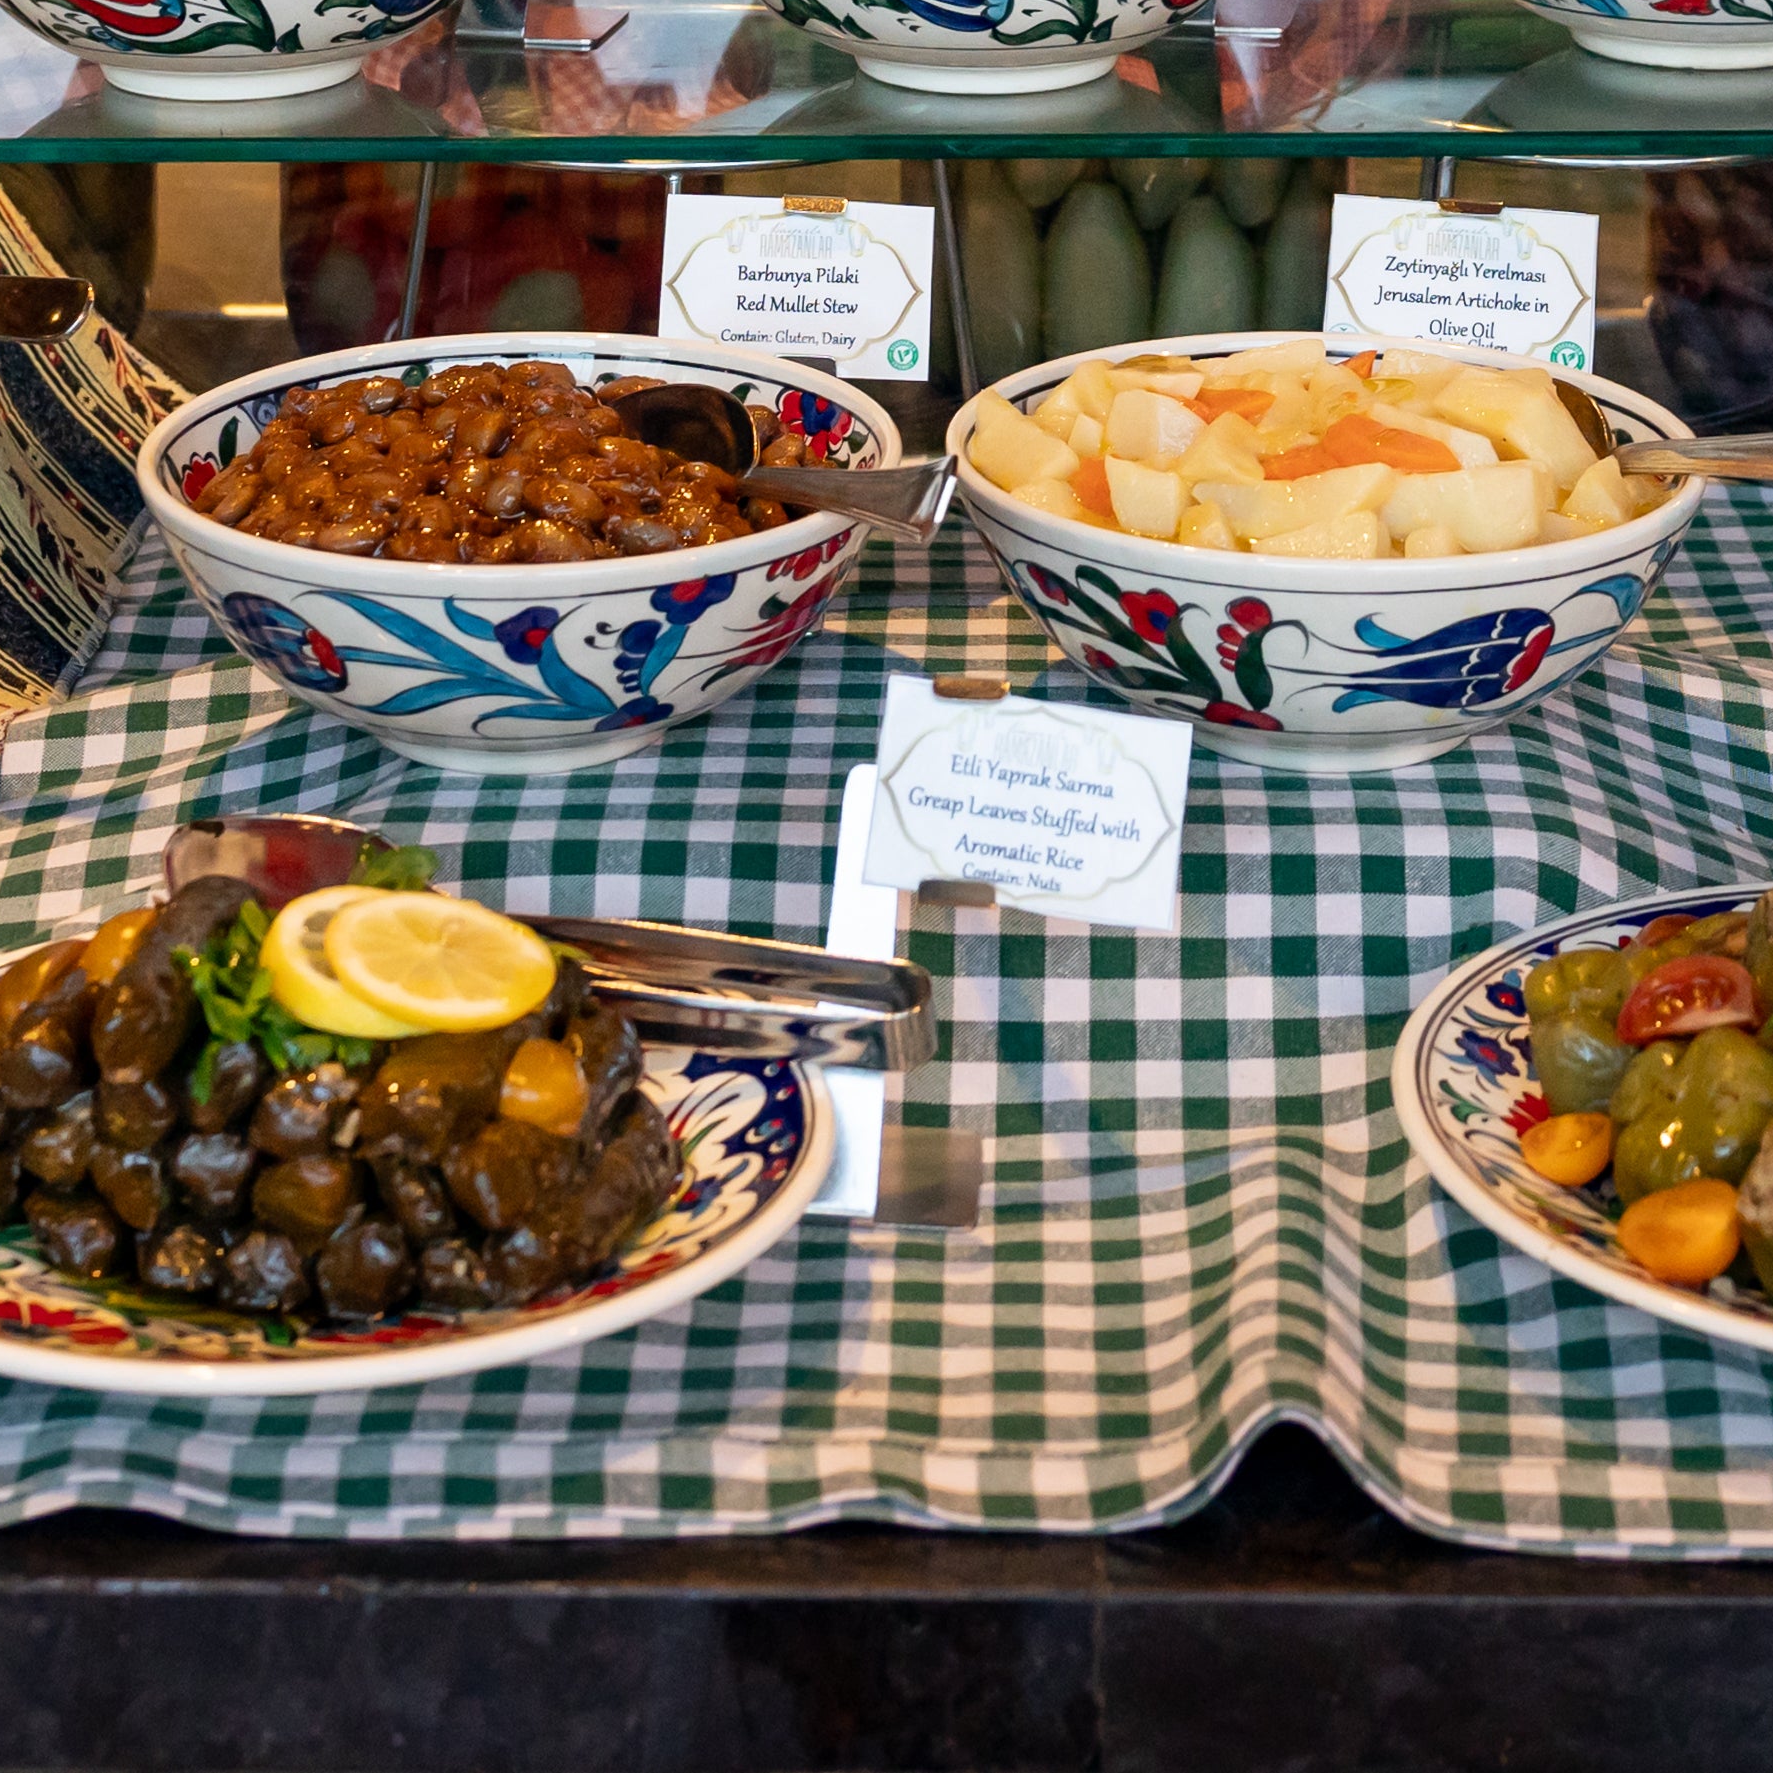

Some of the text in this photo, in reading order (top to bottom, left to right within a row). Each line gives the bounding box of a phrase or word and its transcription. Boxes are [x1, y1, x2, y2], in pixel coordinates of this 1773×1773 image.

[738, 265, 860, 288] Barbunya Pilaki
[1385, 256, 1546, 283] Zeytinyağlı Yerelması
[736, 295, 858, 314] Red Mullet Stew
[1374, 285, 1549, 314] Jerusalem Artichoke in
[721, 329, 857, 349] Contain: Gluten, Dairy
[1429, 318, 1495, 339] Olive Oil
[1468, 338, 1508, 352] Glten
[951, 753, 1114, 799] Etli Yaprak Sarma
[908, 786, 1141, 842] Greap Leaves Stuffed with
[955, 833, 1085, 871] Aromatic Rice
[962, 862, 1062, 893] Contain: Nuts
